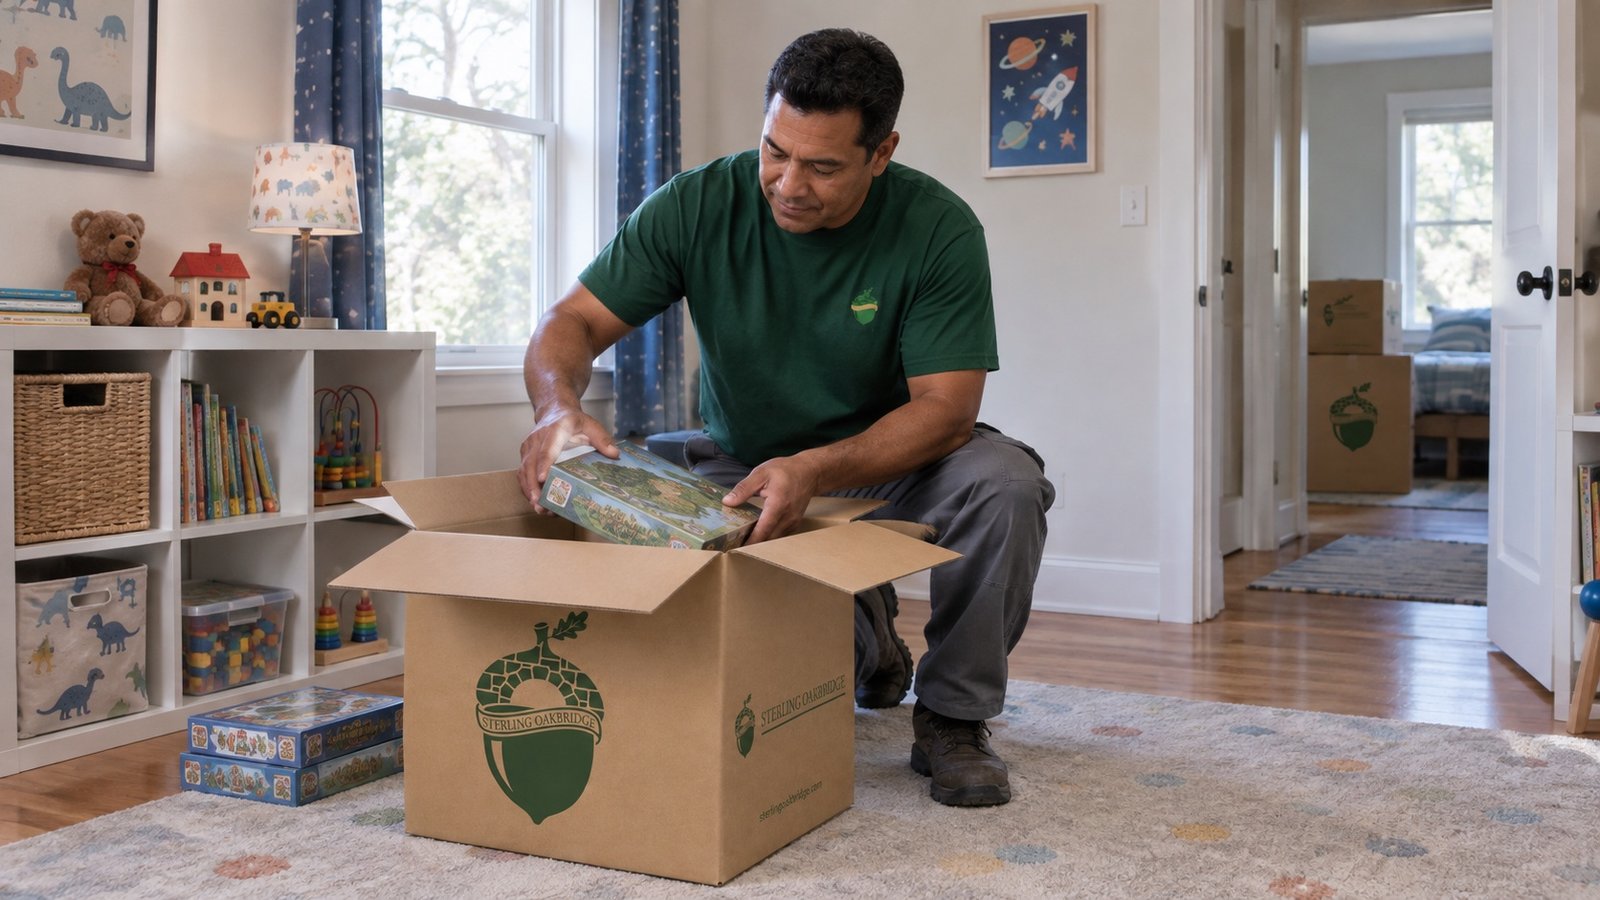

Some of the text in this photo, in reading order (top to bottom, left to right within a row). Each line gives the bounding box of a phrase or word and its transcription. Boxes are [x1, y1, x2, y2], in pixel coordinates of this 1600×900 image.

[761, 675, 846, 727] STERLING OAKBRIDGE
[482, 712, 596, 731] STERLING OAKBRIDGE
